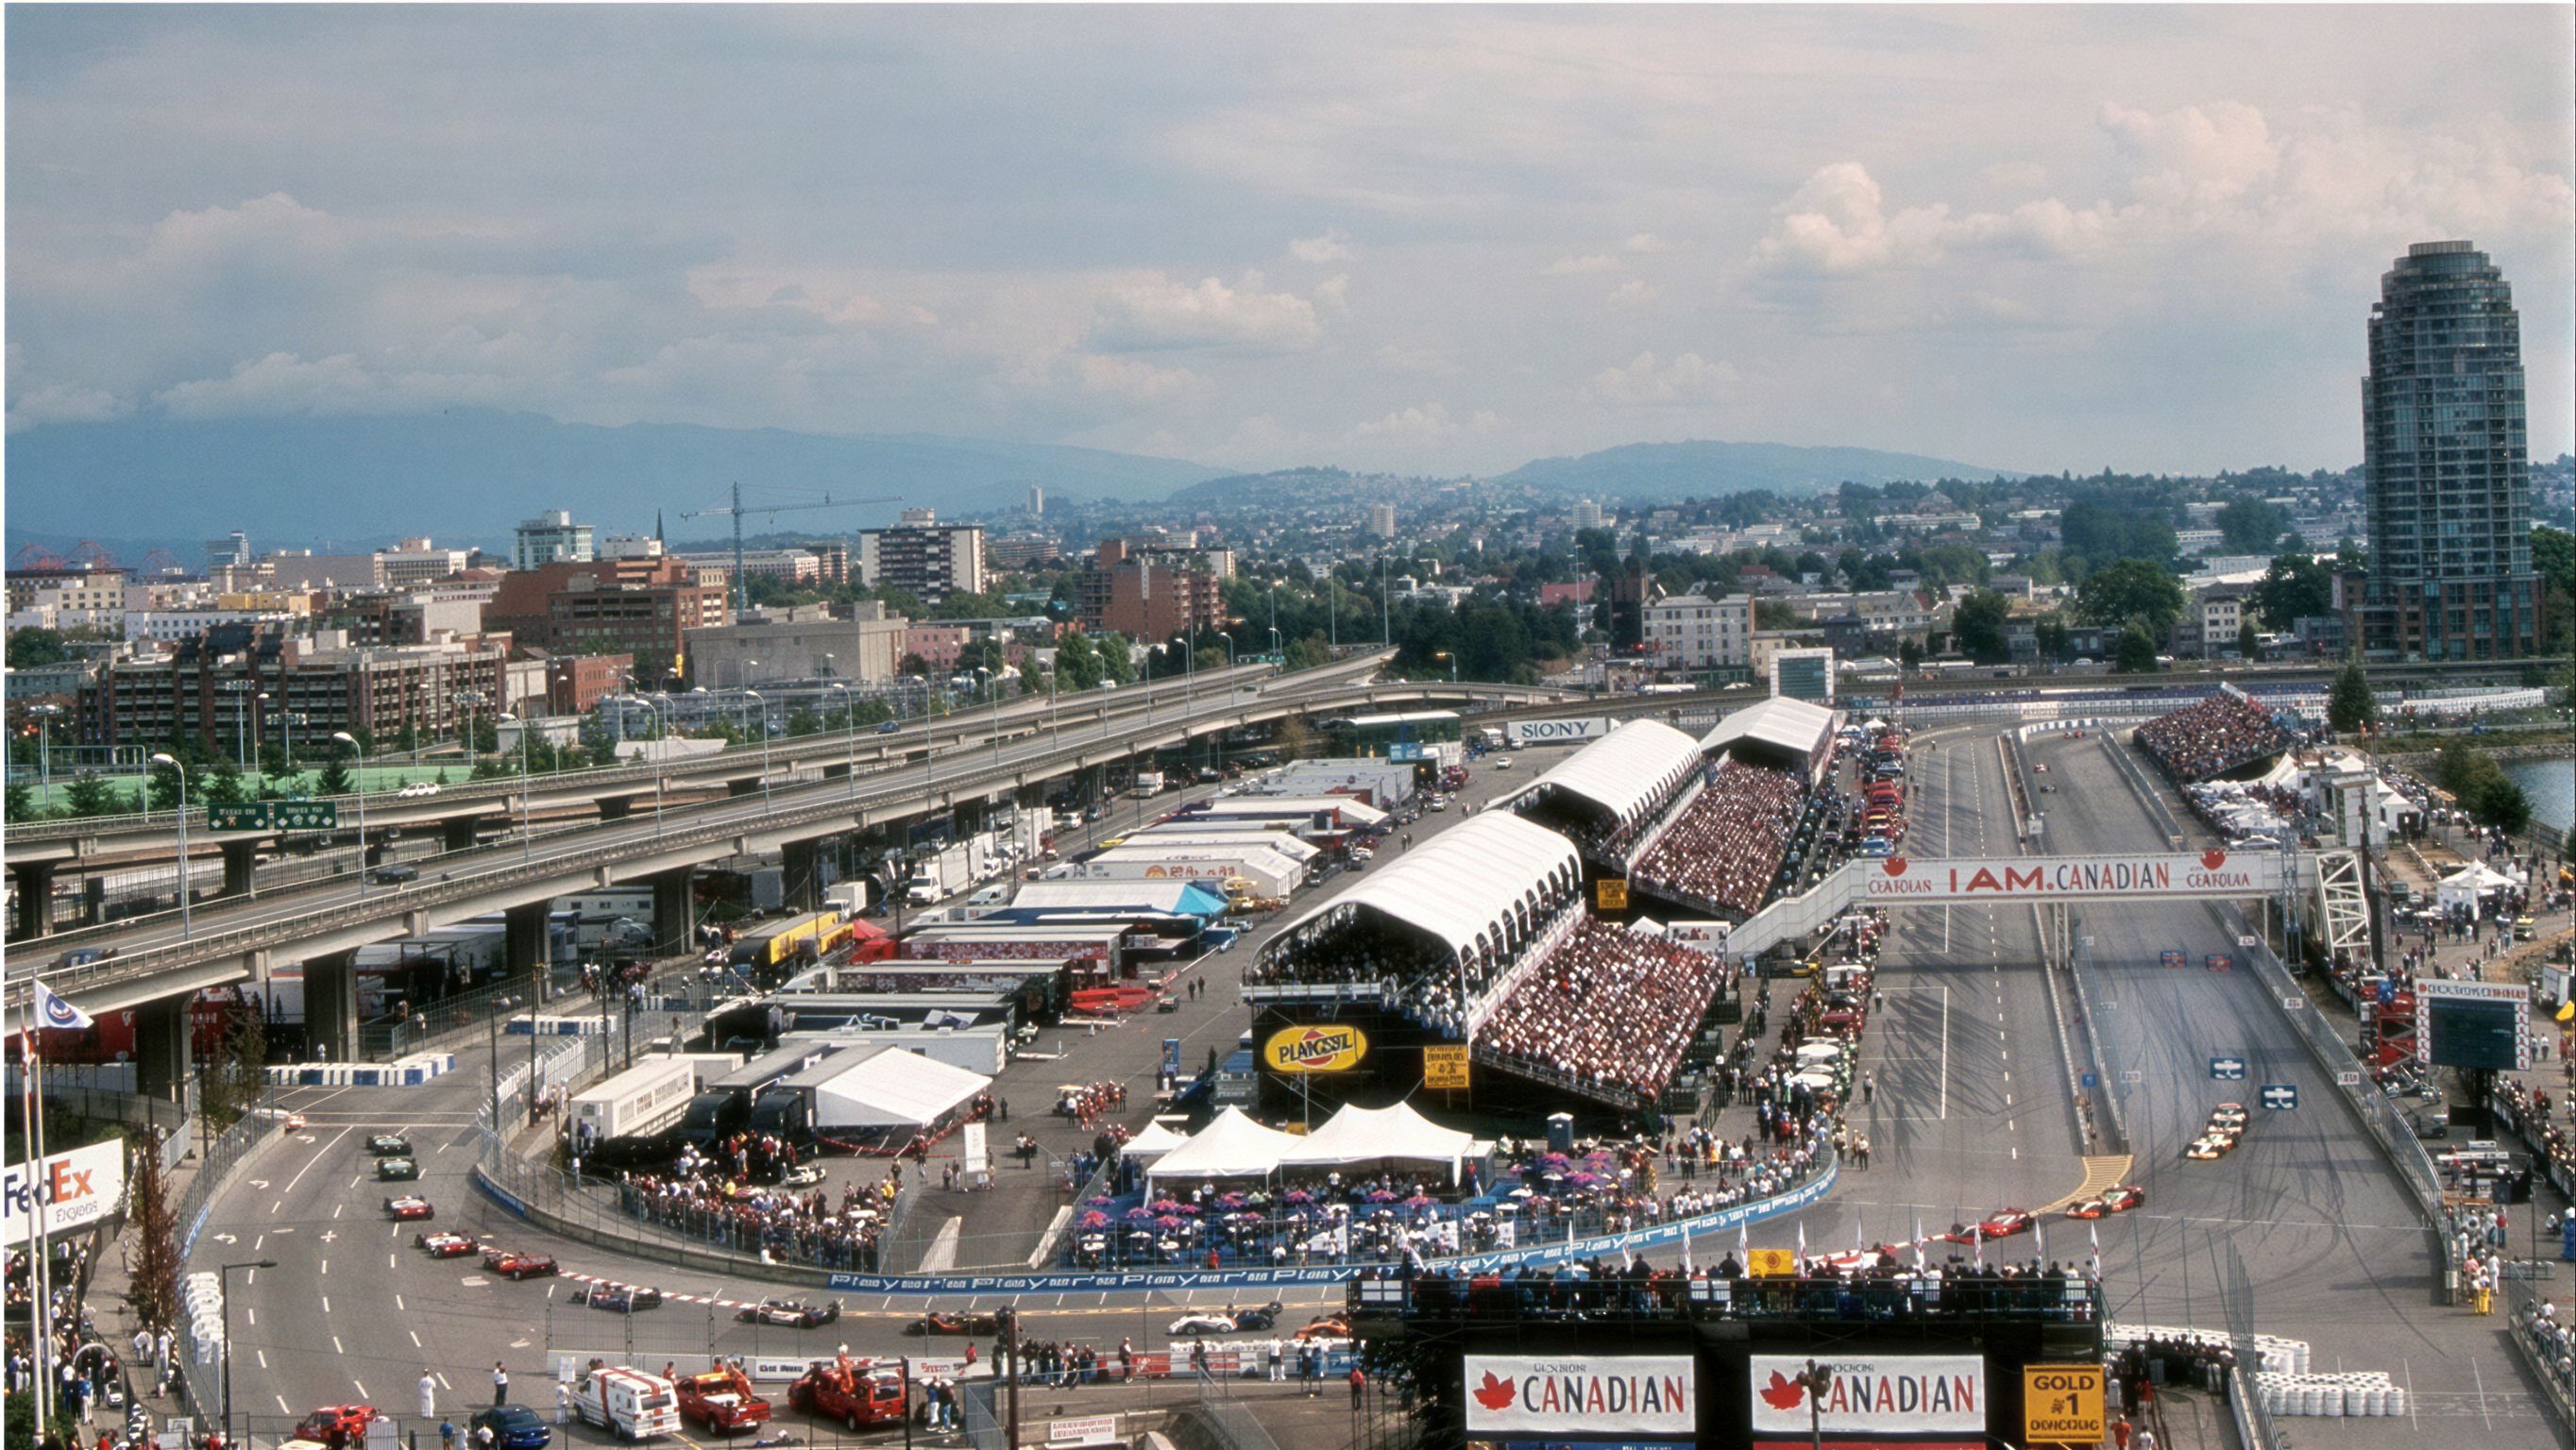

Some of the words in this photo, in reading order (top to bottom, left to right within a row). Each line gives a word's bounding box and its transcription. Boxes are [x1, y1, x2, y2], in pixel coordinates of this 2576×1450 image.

[1520, 721, 1590, 738] SONY
[1949, 868, 1957, 893] I
[2057, 862, 2170, 891] CANADIAN
[5, 1158, 94, 1218] FedEx
[1522, 1375, 1685, 1413] CANADIAN
[1816, 1374, 1974, 1413] ANADIAN
[2033, 1375, 2095, 1391] GOLD
